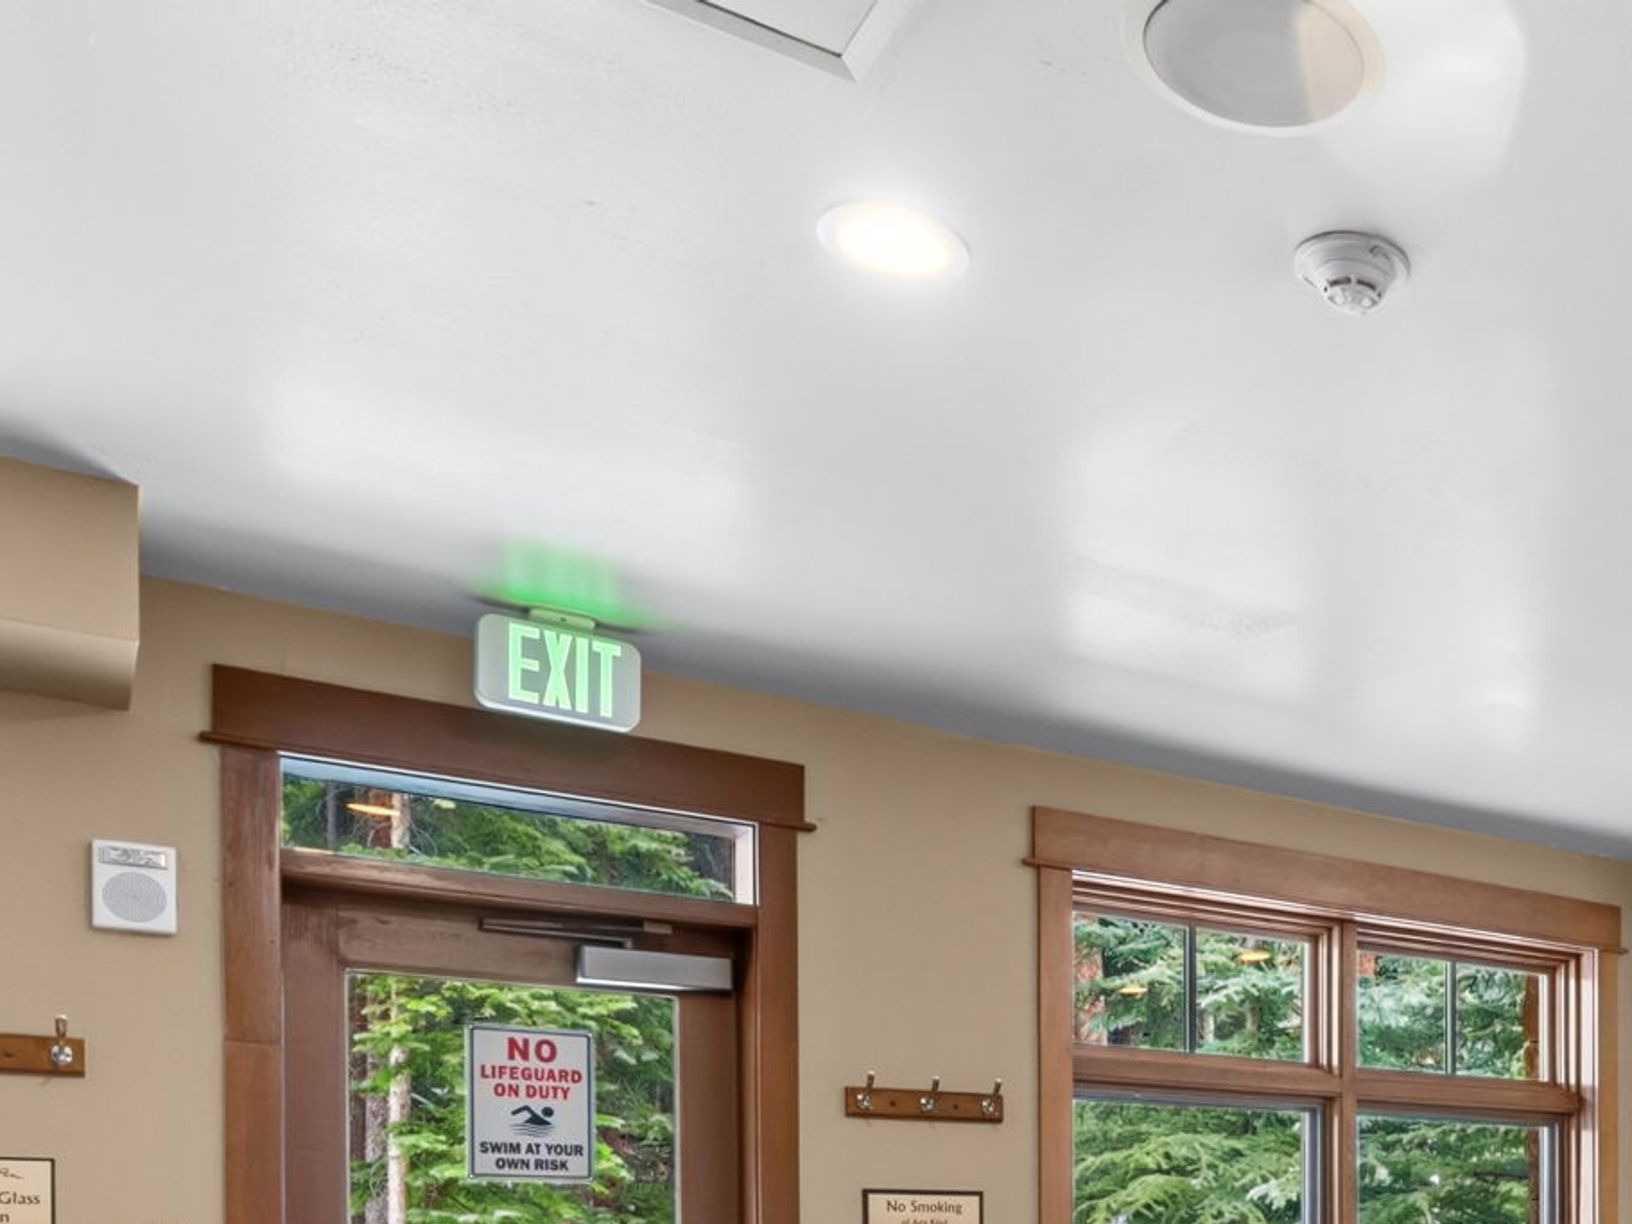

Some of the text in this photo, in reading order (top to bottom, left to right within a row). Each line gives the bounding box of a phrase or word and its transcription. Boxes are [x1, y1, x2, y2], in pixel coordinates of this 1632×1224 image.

[508, 621, 621, 718] EXIT
[507, 1037, 557, 1063] NO
[480, 1065, 582, 1084] LIFEGUARD
[493, 1084, 571, 1100] ON DUTY
[480, 1141, 583, 1156] SWIM AT YOUR
[495, 1158, 569, 1171] OWN RISK
[0, 1191, 41, 1205] Glass
[886, 1199, 962, 1215] No Smoking
